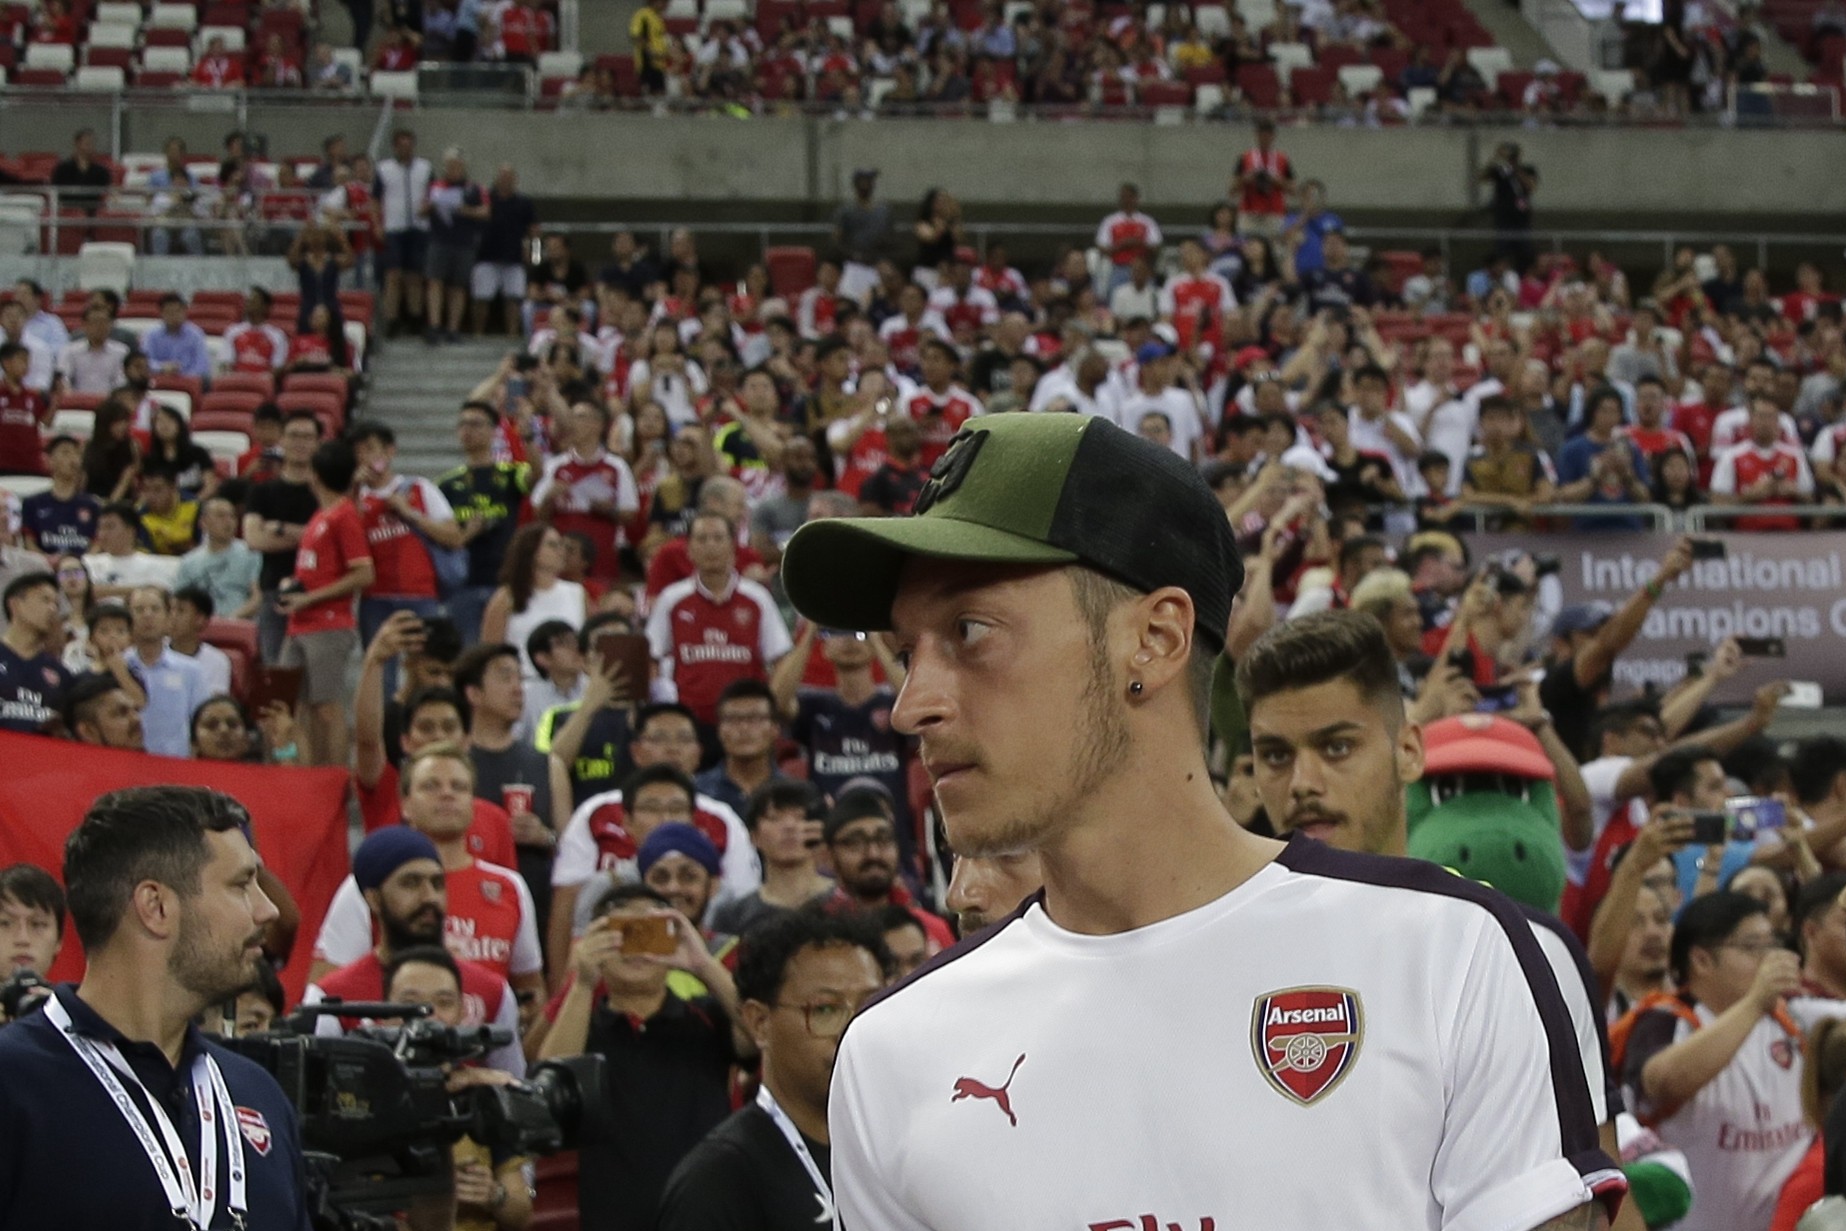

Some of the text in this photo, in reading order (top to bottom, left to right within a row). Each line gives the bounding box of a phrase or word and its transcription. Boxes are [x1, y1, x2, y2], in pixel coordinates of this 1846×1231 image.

[1581, 550, 1842, 592] Intenational
[1641, 599, 1822, 648] ampions
[1267, 1003, 1345, 1026] Arsenal
[115, 1091, 156, 1155] Champions
[153, 1153, 169, 1181] Cup
